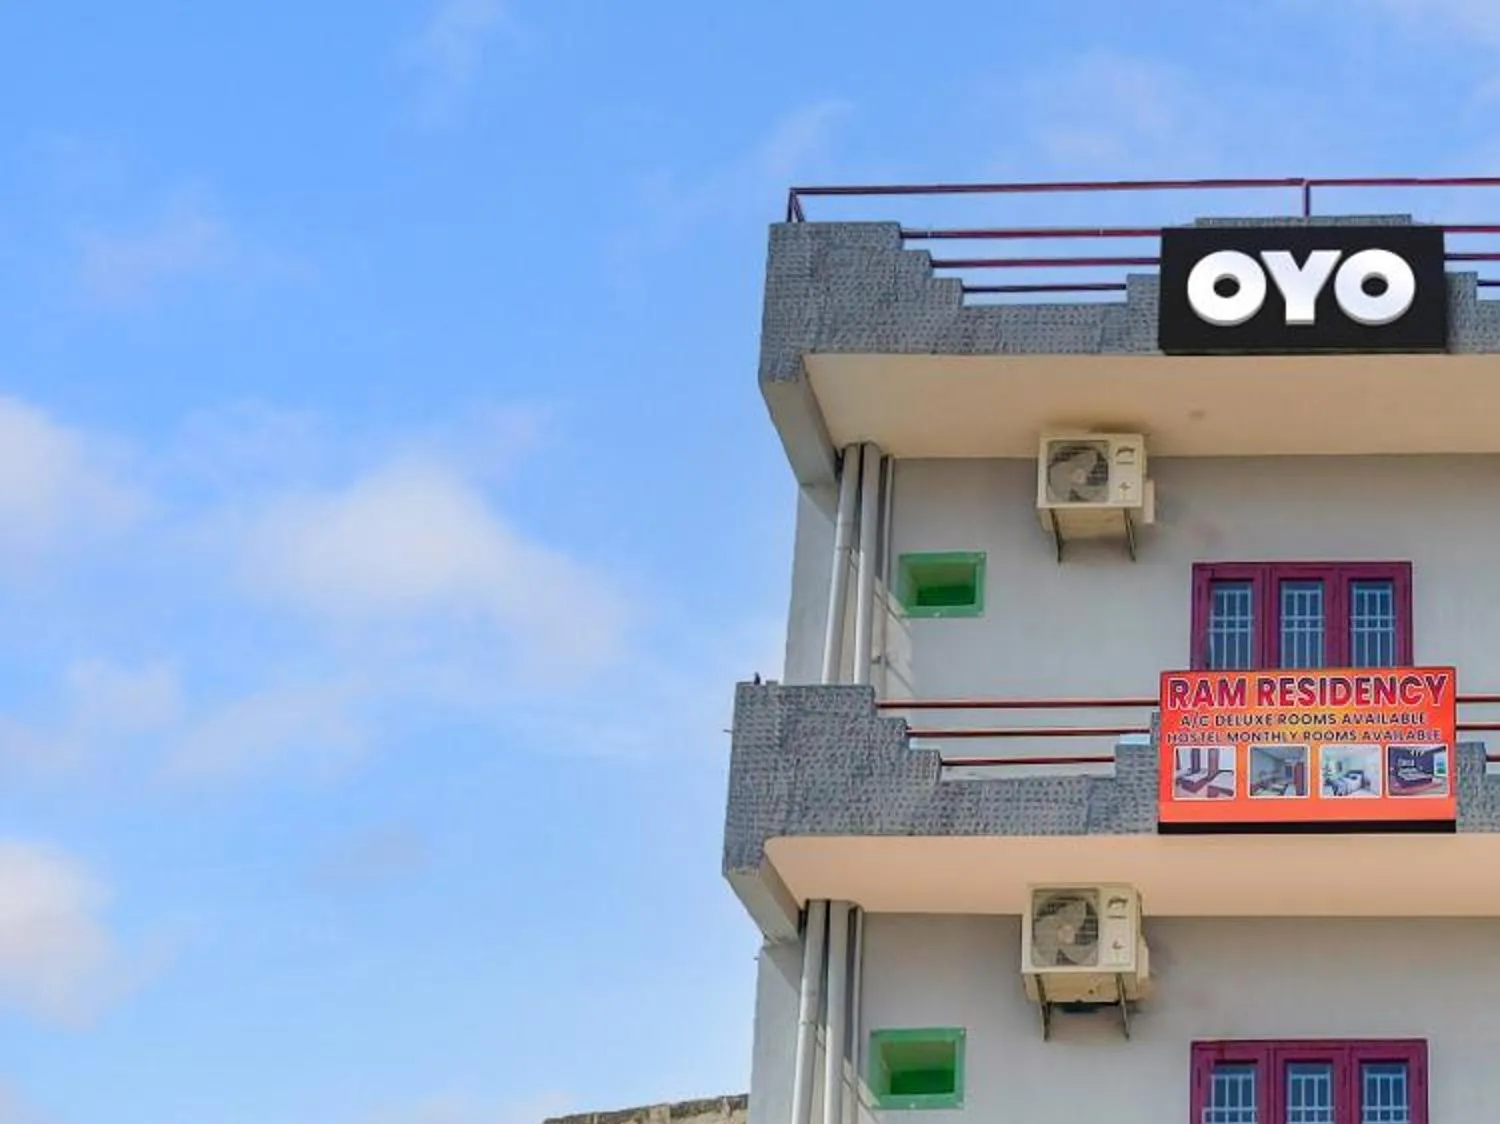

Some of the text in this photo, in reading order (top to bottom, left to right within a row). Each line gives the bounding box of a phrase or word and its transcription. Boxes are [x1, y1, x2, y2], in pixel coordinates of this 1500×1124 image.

[1187, 248, 1416, 326] OYO
[1168, 673, 1449, 710] RAM RESIDENCY
[1215, 713, 1273, 727] DELUXE
[1277, 713, 1337, 726] ROOMS
[1167, 728, 1441, 744] HOSTEL MONTHLY ROOMS AVAILABLE
